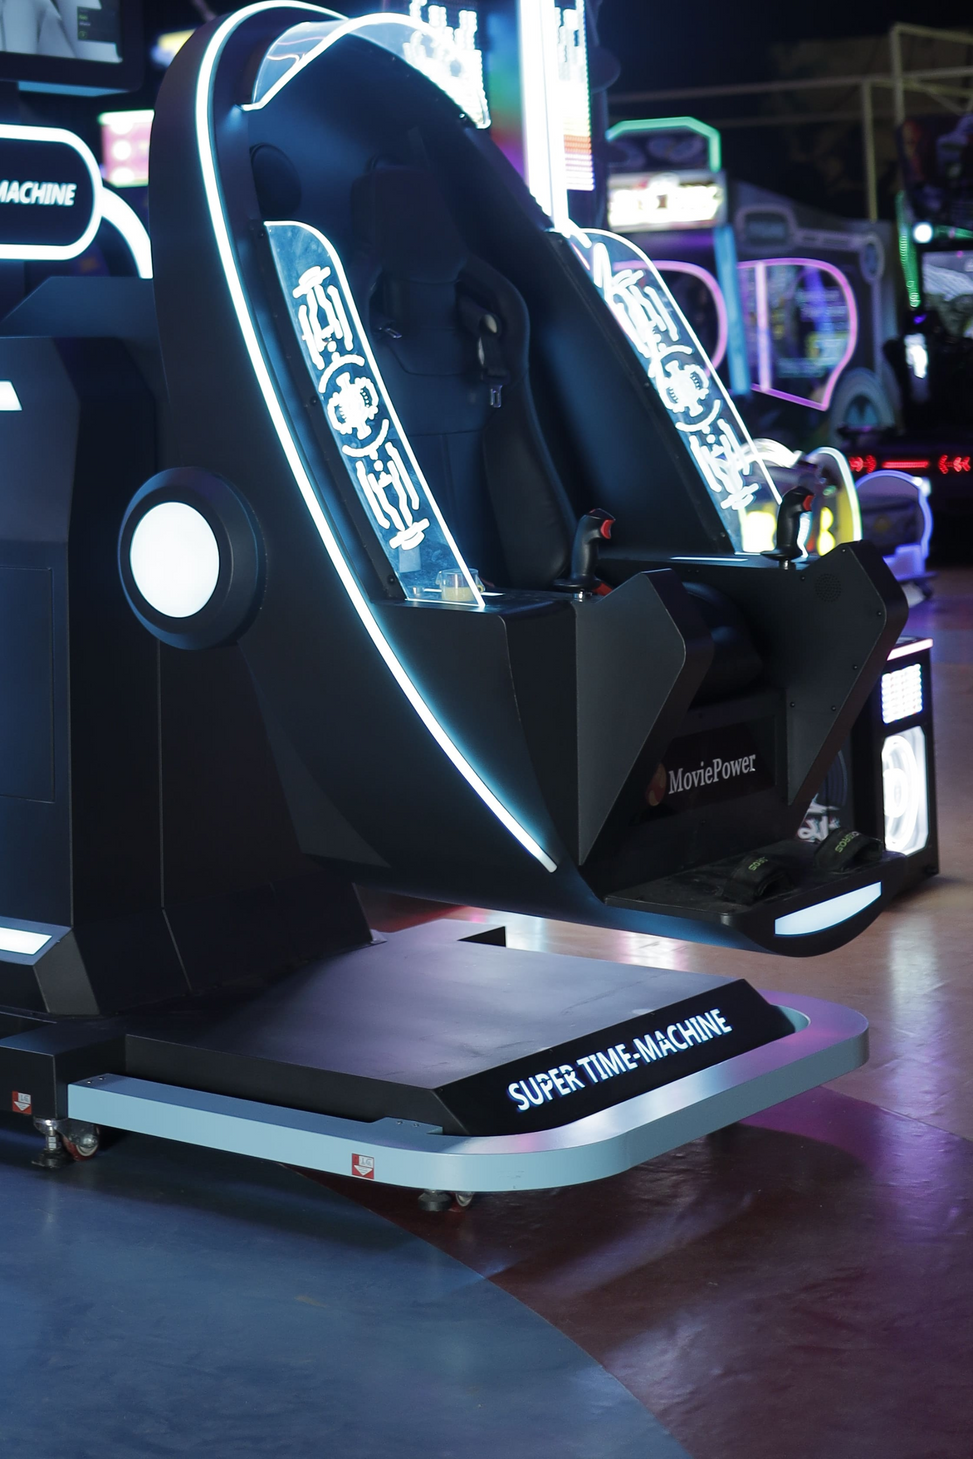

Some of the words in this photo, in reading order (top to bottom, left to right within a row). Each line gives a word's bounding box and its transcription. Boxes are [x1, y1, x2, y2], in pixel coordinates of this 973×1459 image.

[668, 753, 757, 795] MoviePower
[507, 1063, 585, 1112] SUPER
[576, 1007, 733, 1084] TIME-MACHINE
